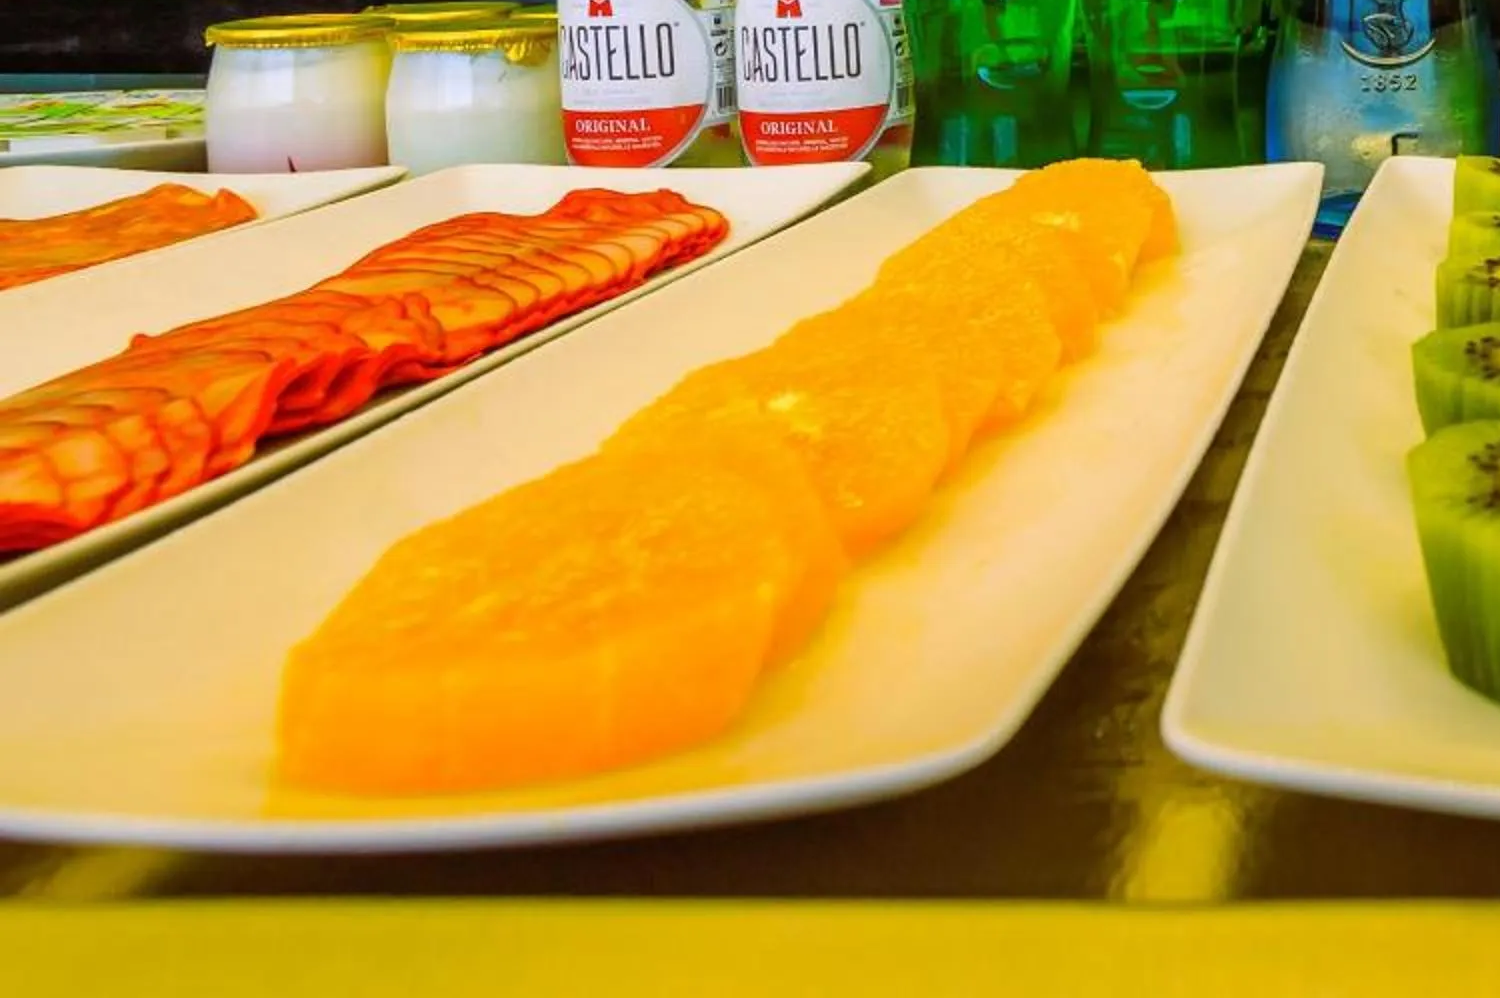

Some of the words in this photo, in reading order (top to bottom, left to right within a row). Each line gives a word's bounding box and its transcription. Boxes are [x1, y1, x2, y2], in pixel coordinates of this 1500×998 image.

[741, 22, 862, 83] CASTELLO
[575, 117, 651, 134] ORIGINAL
[760, 120, 837, 136] ORIGINAL
